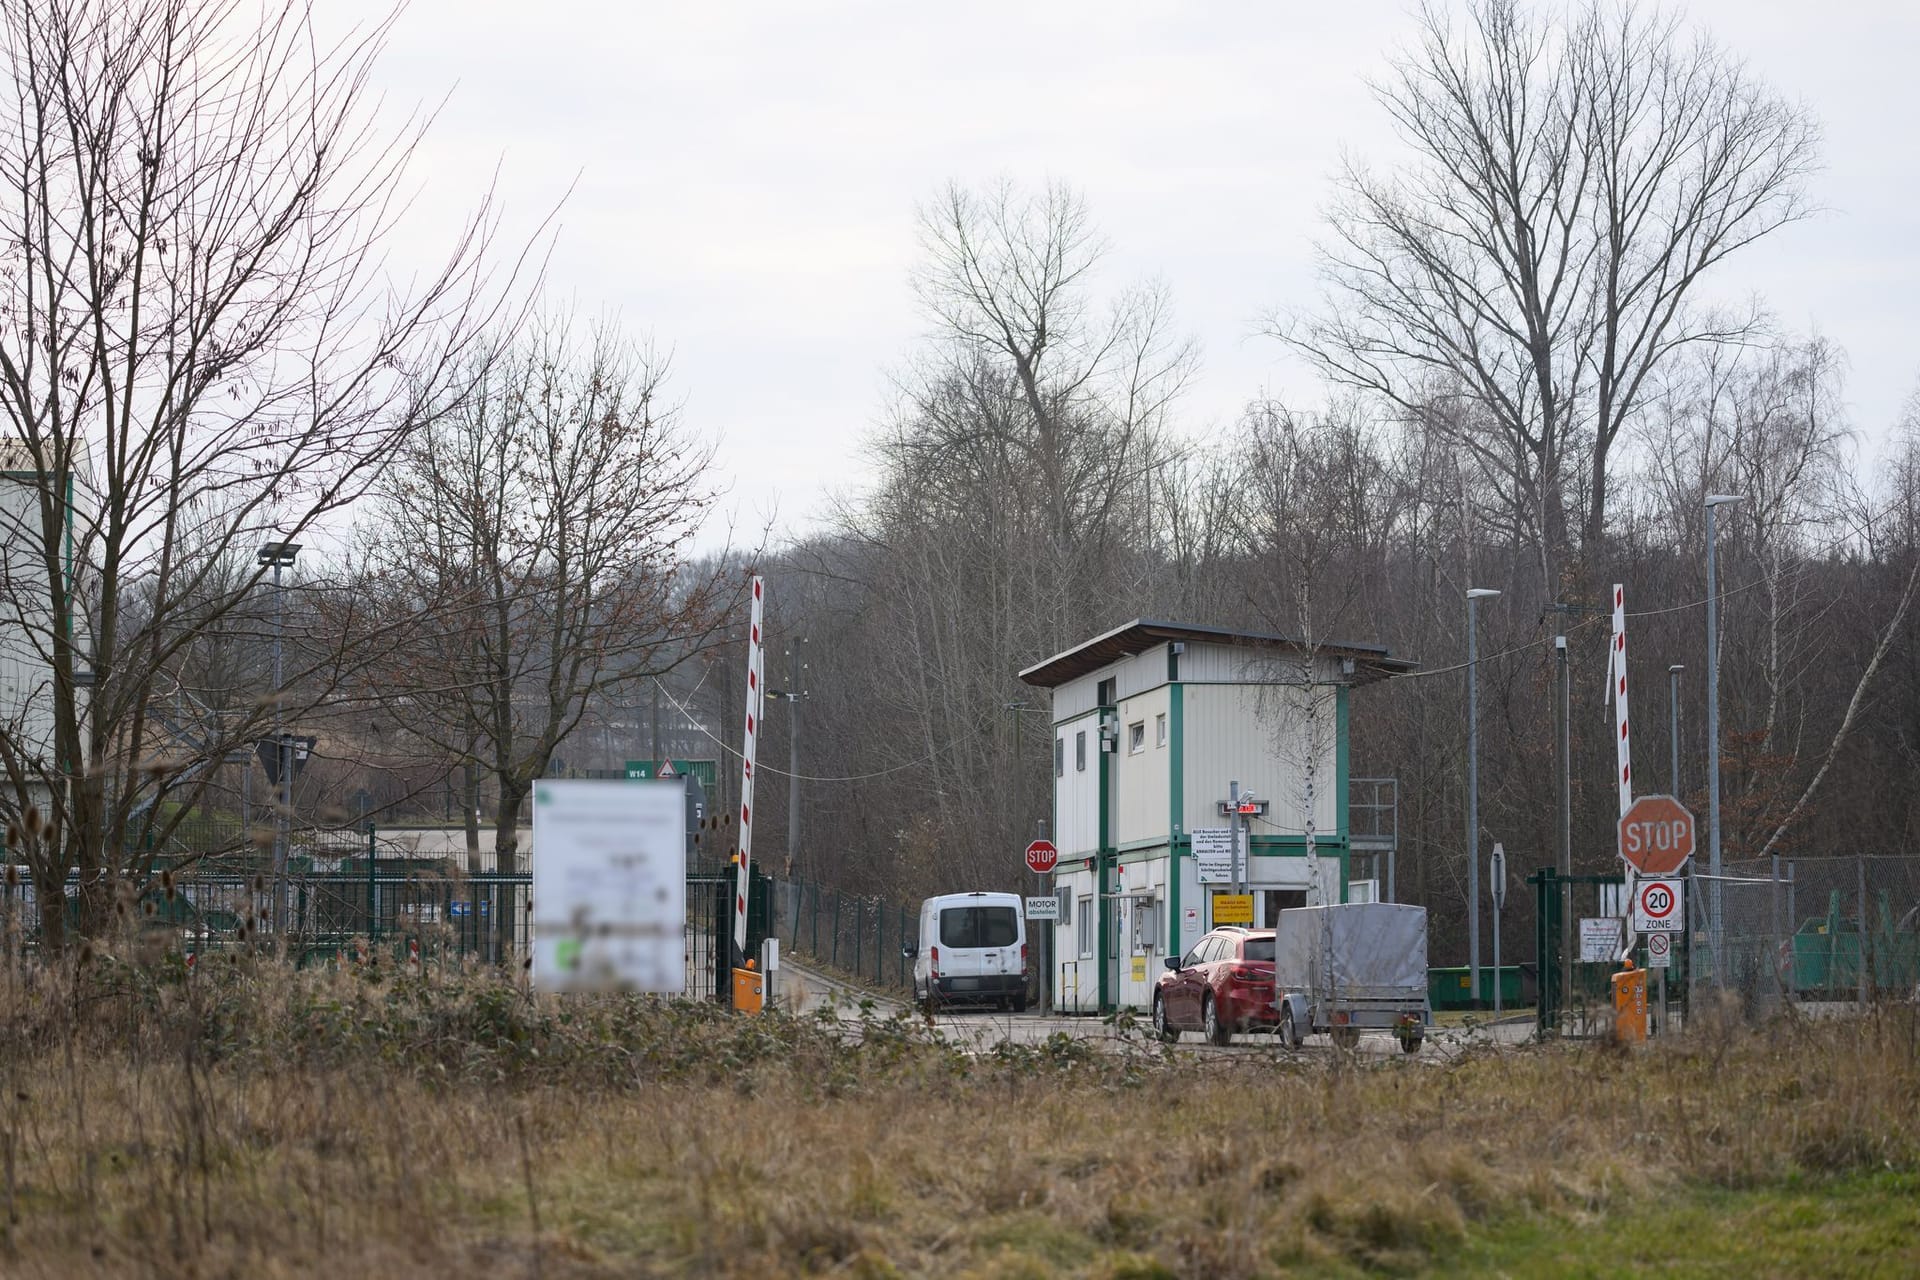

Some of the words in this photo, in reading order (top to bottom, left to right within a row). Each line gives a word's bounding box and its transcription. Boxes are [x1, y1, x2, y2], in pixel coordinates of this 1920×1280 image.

[629, 770, 646, 778] W14
[1626, 820, 1687, 852] STOP
[1028, 850, 1055, 863] STOP
[1649, 892, 1668, 908] 20
[1646, 920, 1671, 928] ZONE
